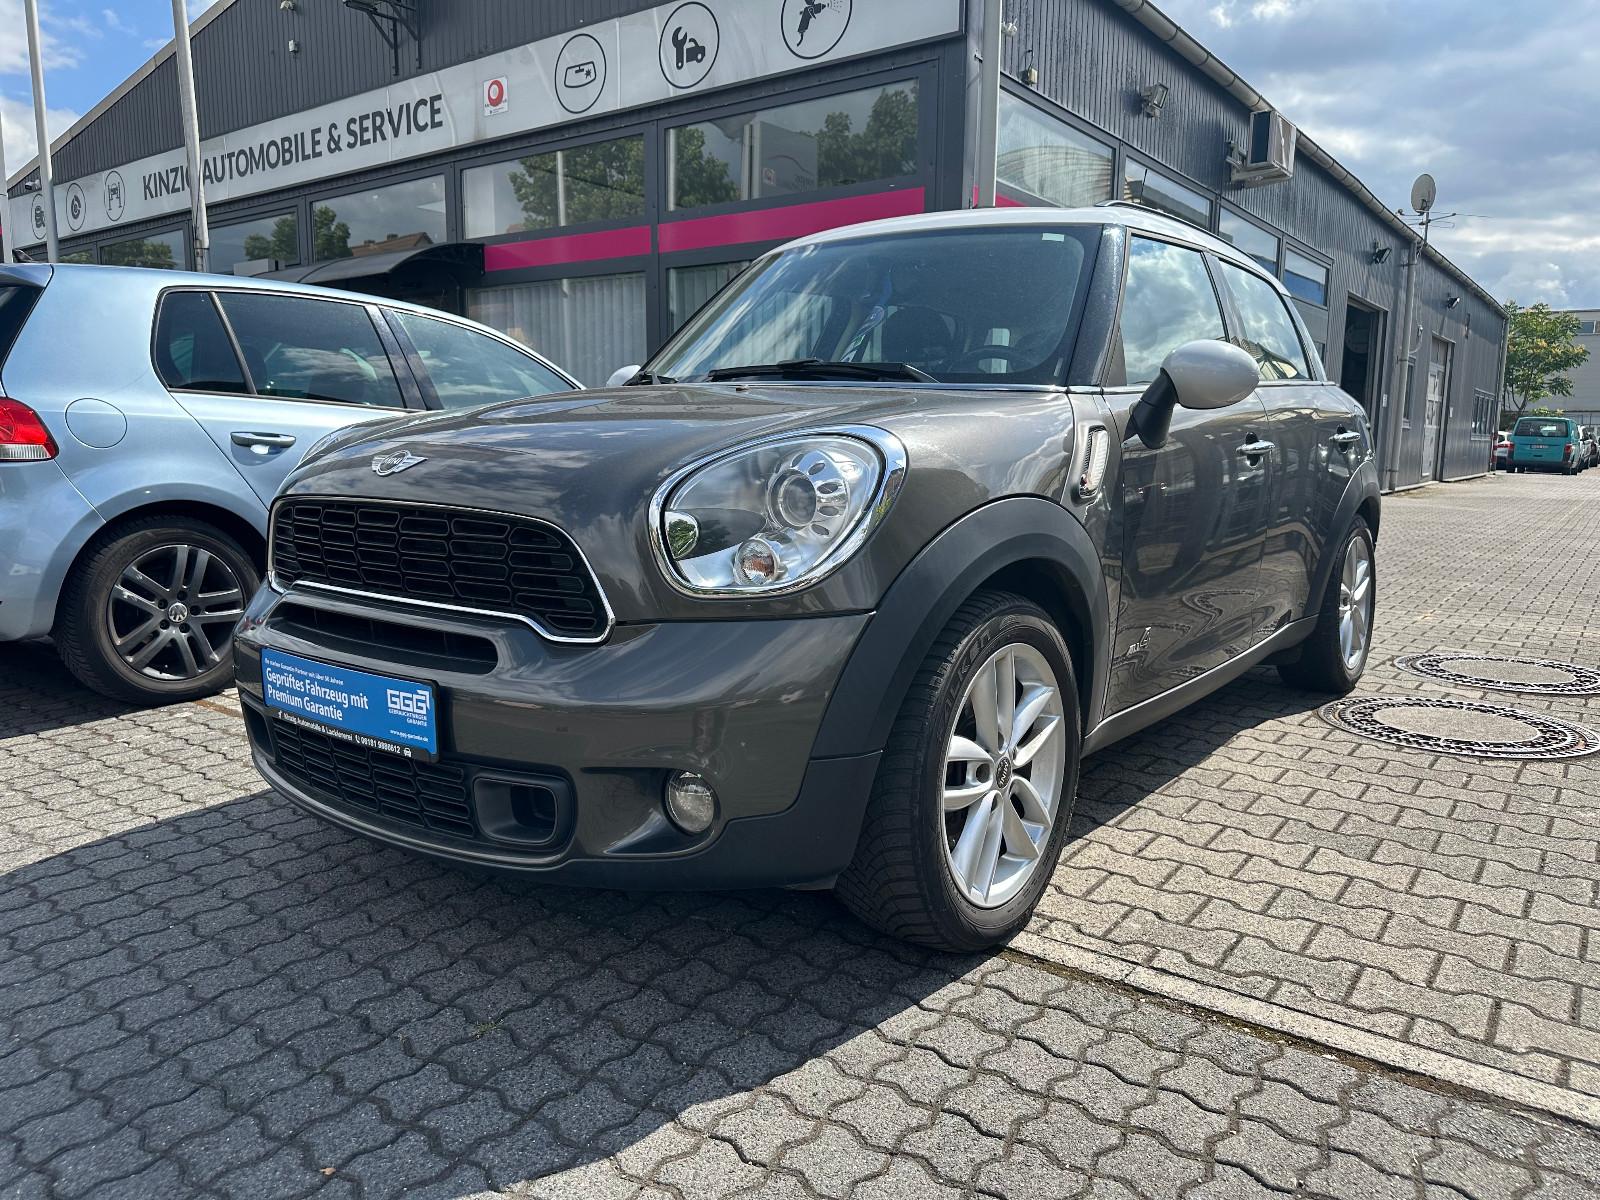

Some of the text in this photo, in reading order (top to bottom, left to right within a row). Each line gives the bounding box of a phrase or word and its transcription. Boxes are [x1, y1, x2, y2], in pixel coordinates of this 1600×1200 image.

[203, 127, 322, 185] AUTOMOBILE
[327, 123, 342, 154] &
[346, 93, 443, 149] SERVICE
[266, 667, 369, 710] Geprüftes Fahrzeug mit
[267, 684, 343, 721] Premium Garantie
[386, 688, 430, 715] GGG
